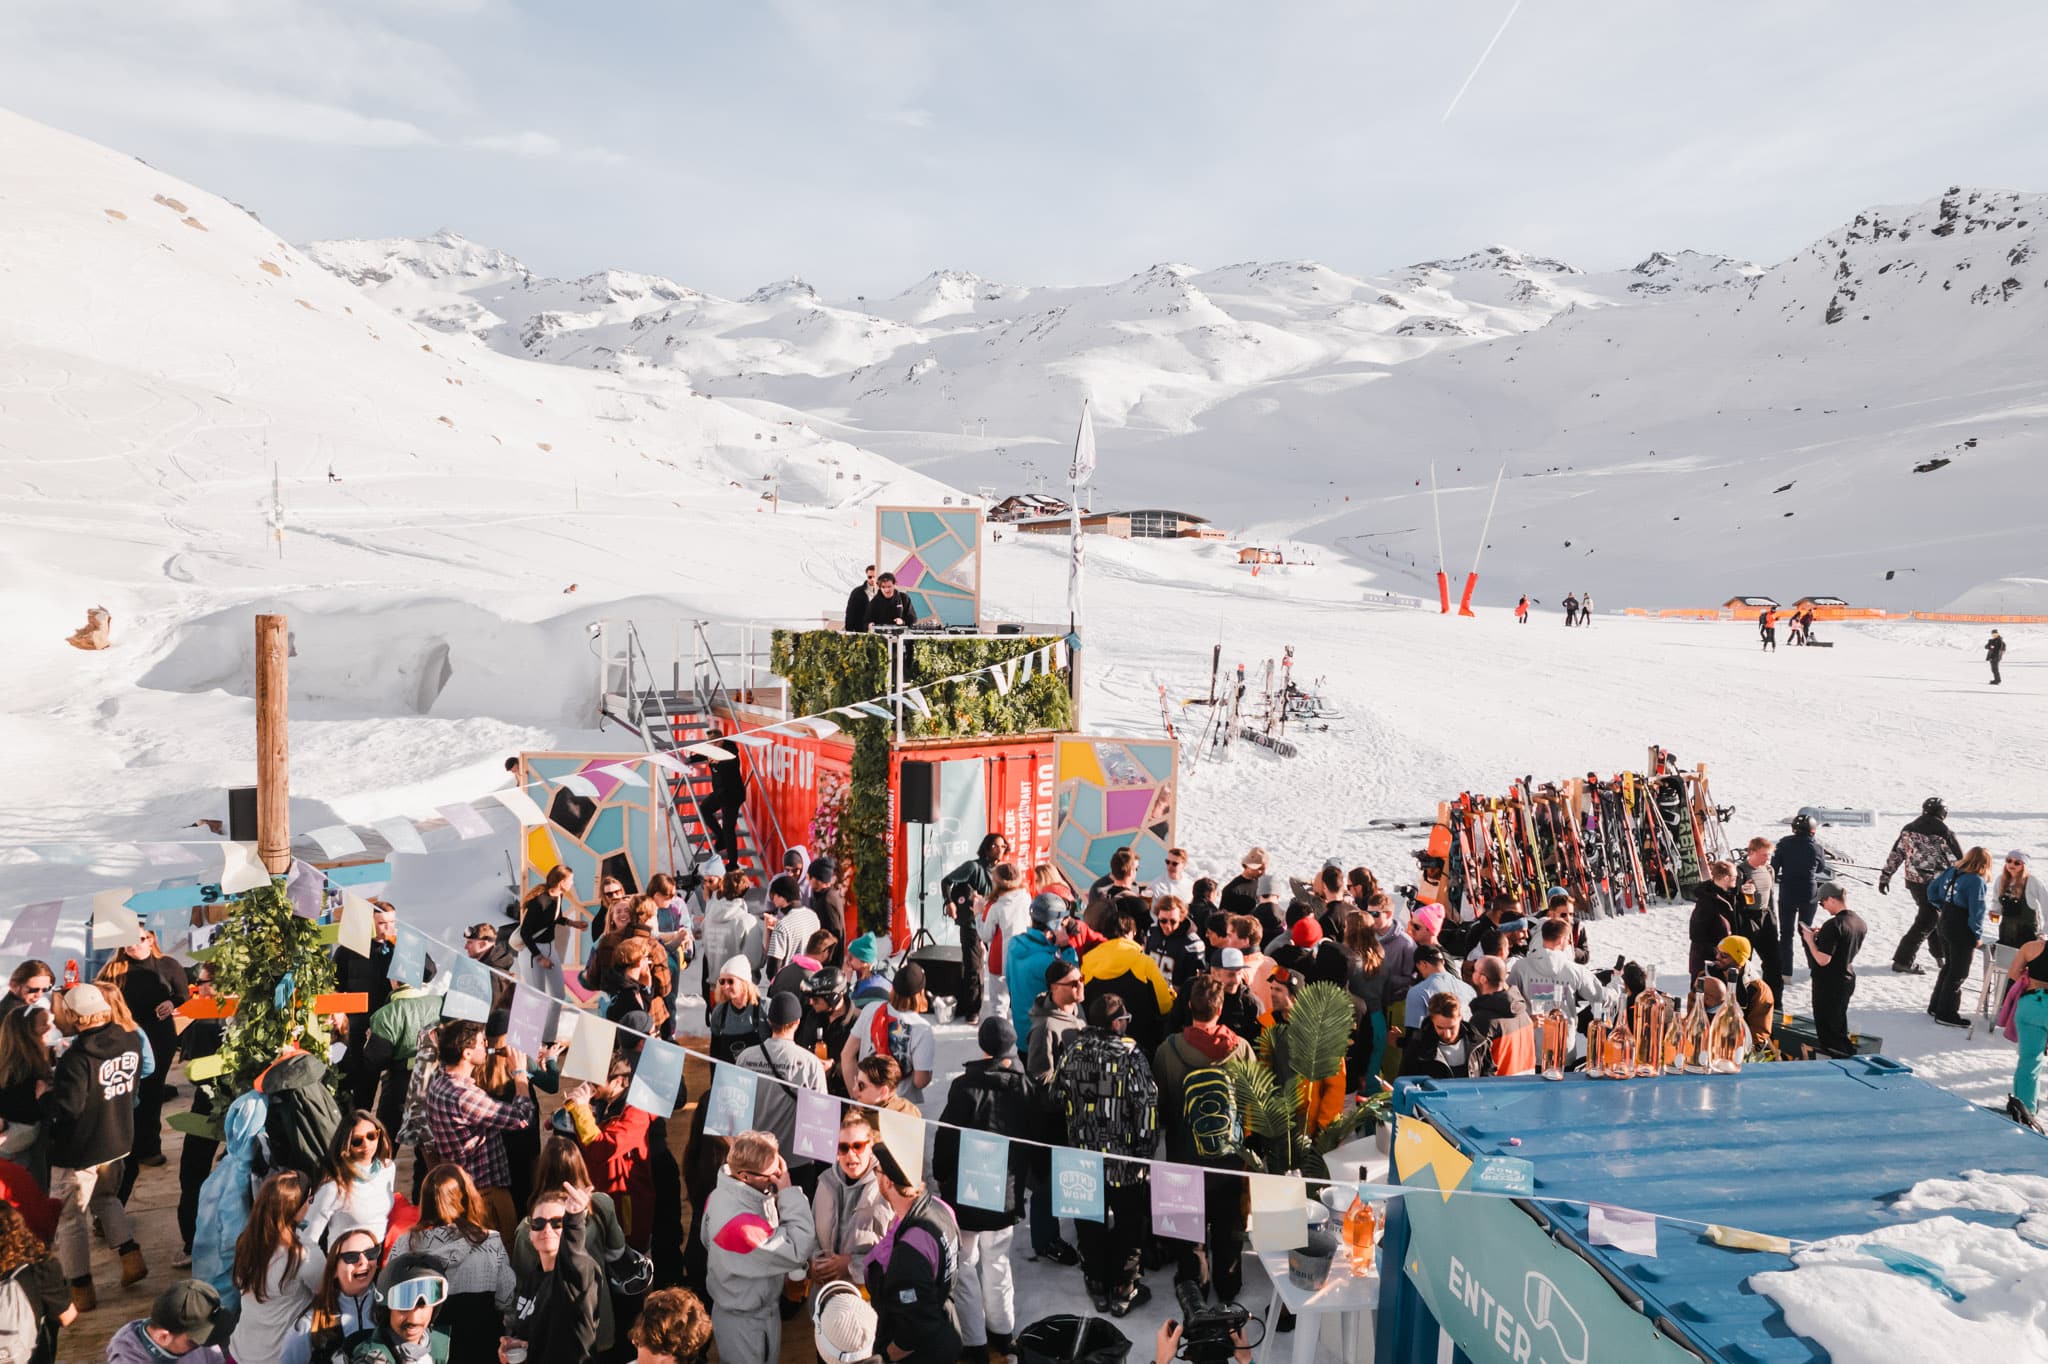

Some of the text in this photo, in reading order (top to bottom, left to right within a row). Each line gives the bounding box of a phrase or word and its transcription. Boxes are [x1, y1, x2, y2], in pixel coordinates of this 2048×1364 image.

[1018, 781, 1032, 841] RESTAURANT
[922, 839, 969, 859] ENTER
[1448, 1255, 1533, 1364] ENTER
